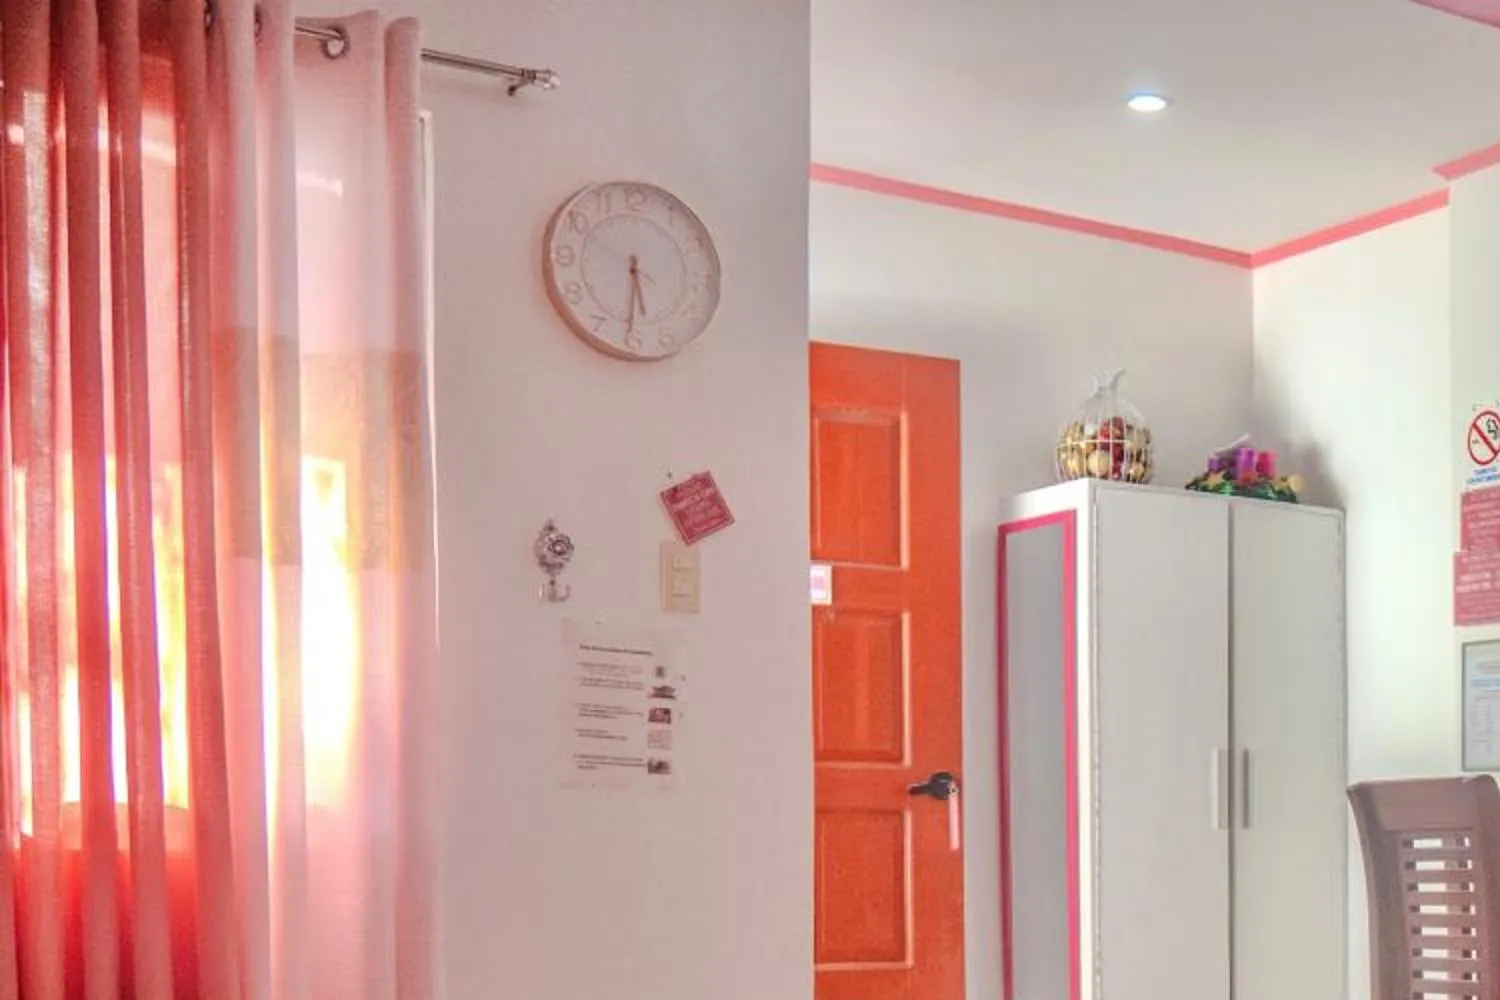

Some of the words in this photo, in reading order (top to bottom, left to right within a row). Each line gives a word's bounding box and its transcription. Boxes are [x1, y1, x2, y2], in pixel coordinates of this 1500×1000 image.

[625, 185, 648, 212] 12
[567, 209, 590, 236] 10
[556, 244, 576, 268] 9
